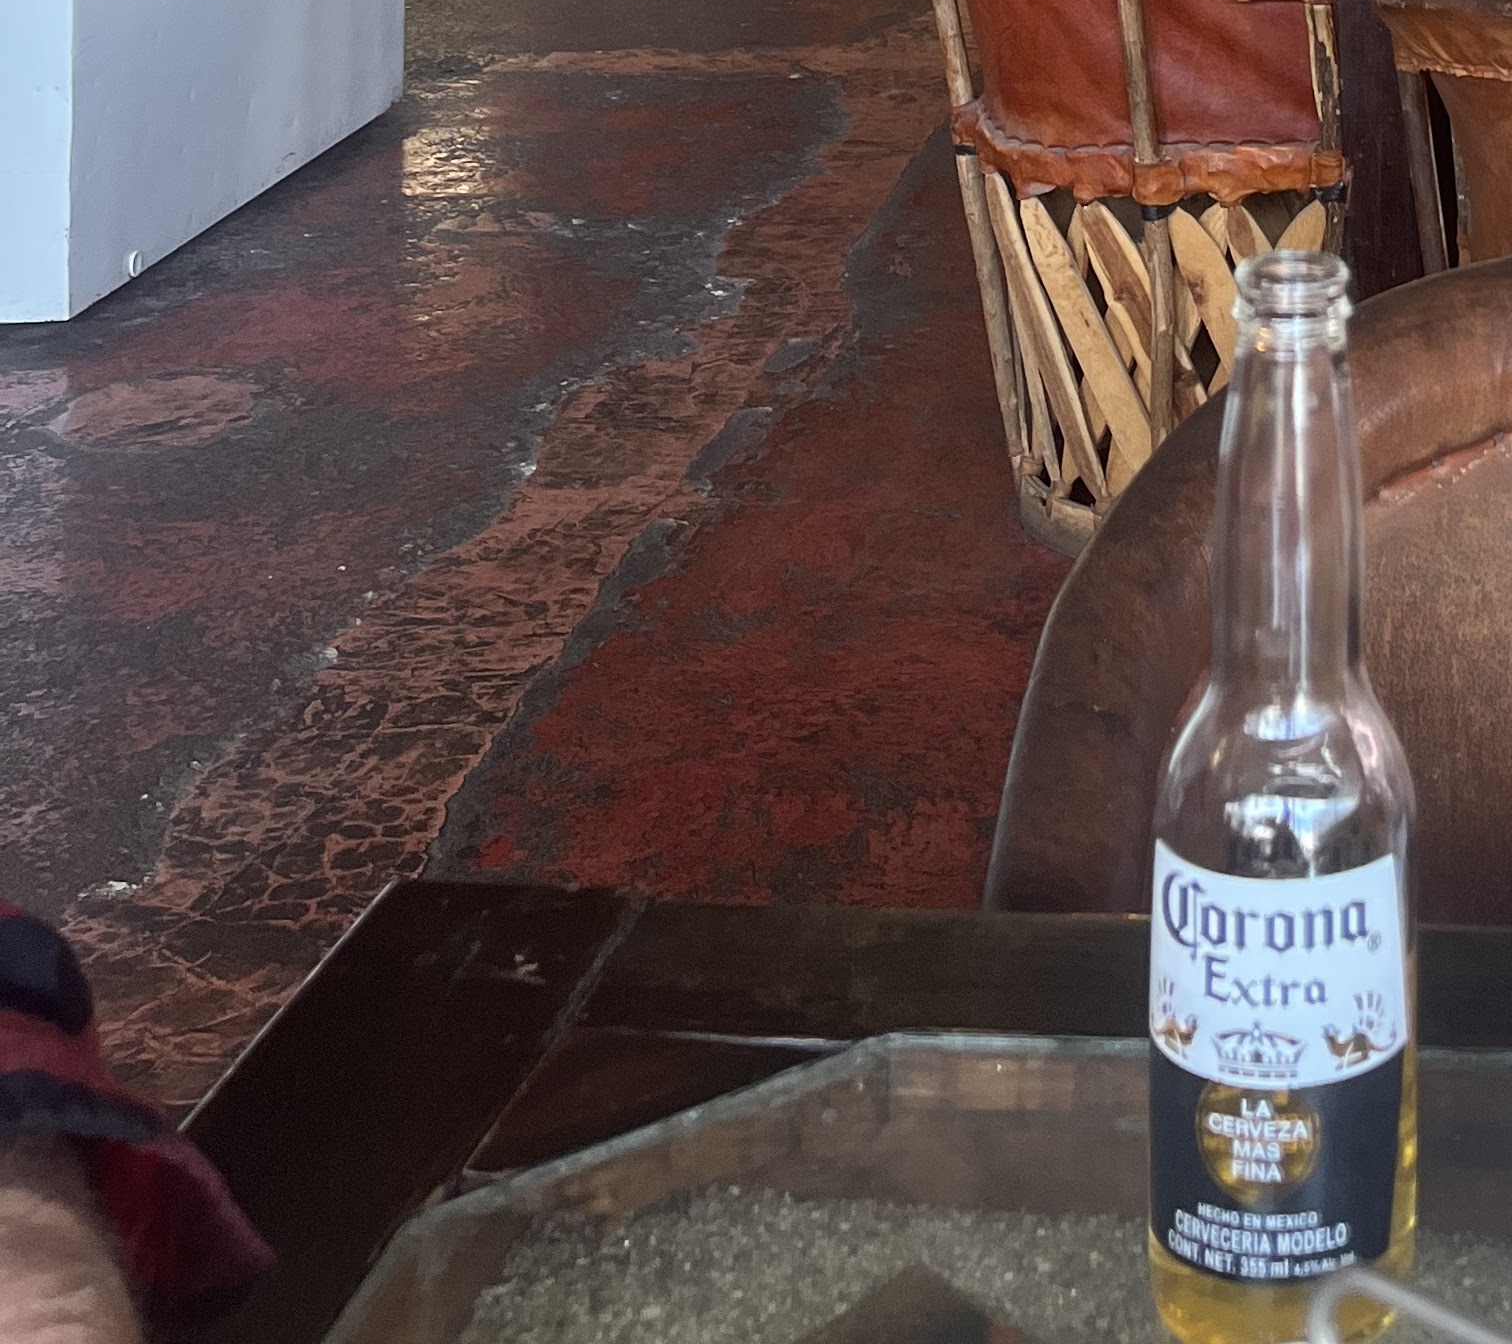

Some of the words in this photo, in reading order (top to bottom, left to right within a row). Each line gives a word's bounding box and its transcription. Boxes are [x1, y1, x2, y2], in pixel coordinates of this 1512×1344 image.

[1162, 870, 1369, 962] Corona
[1202, 952, 1329, 1009] Extra
[1241, 1097, 1272, 1119] LA
[1207, 1112, 1309, 1142] CERVEZA
[1232, 1139, 1282, 1163] MAS
[1231, 1159, 1283, 1183] FINA
[1197, 1202, 1241, 1228] HECHO
[1243, 1213, 1262, 1230] EN
[1265, 1211, 1319, 1231] MEXICO
[1175, 1208, 1272, 1256] CERVECERIA
[1277, 1222, 1348, 1256] MODELO
[1240, 1255, 1267, 1279] 355
[1270, 1257, 1290, 1279] ml
